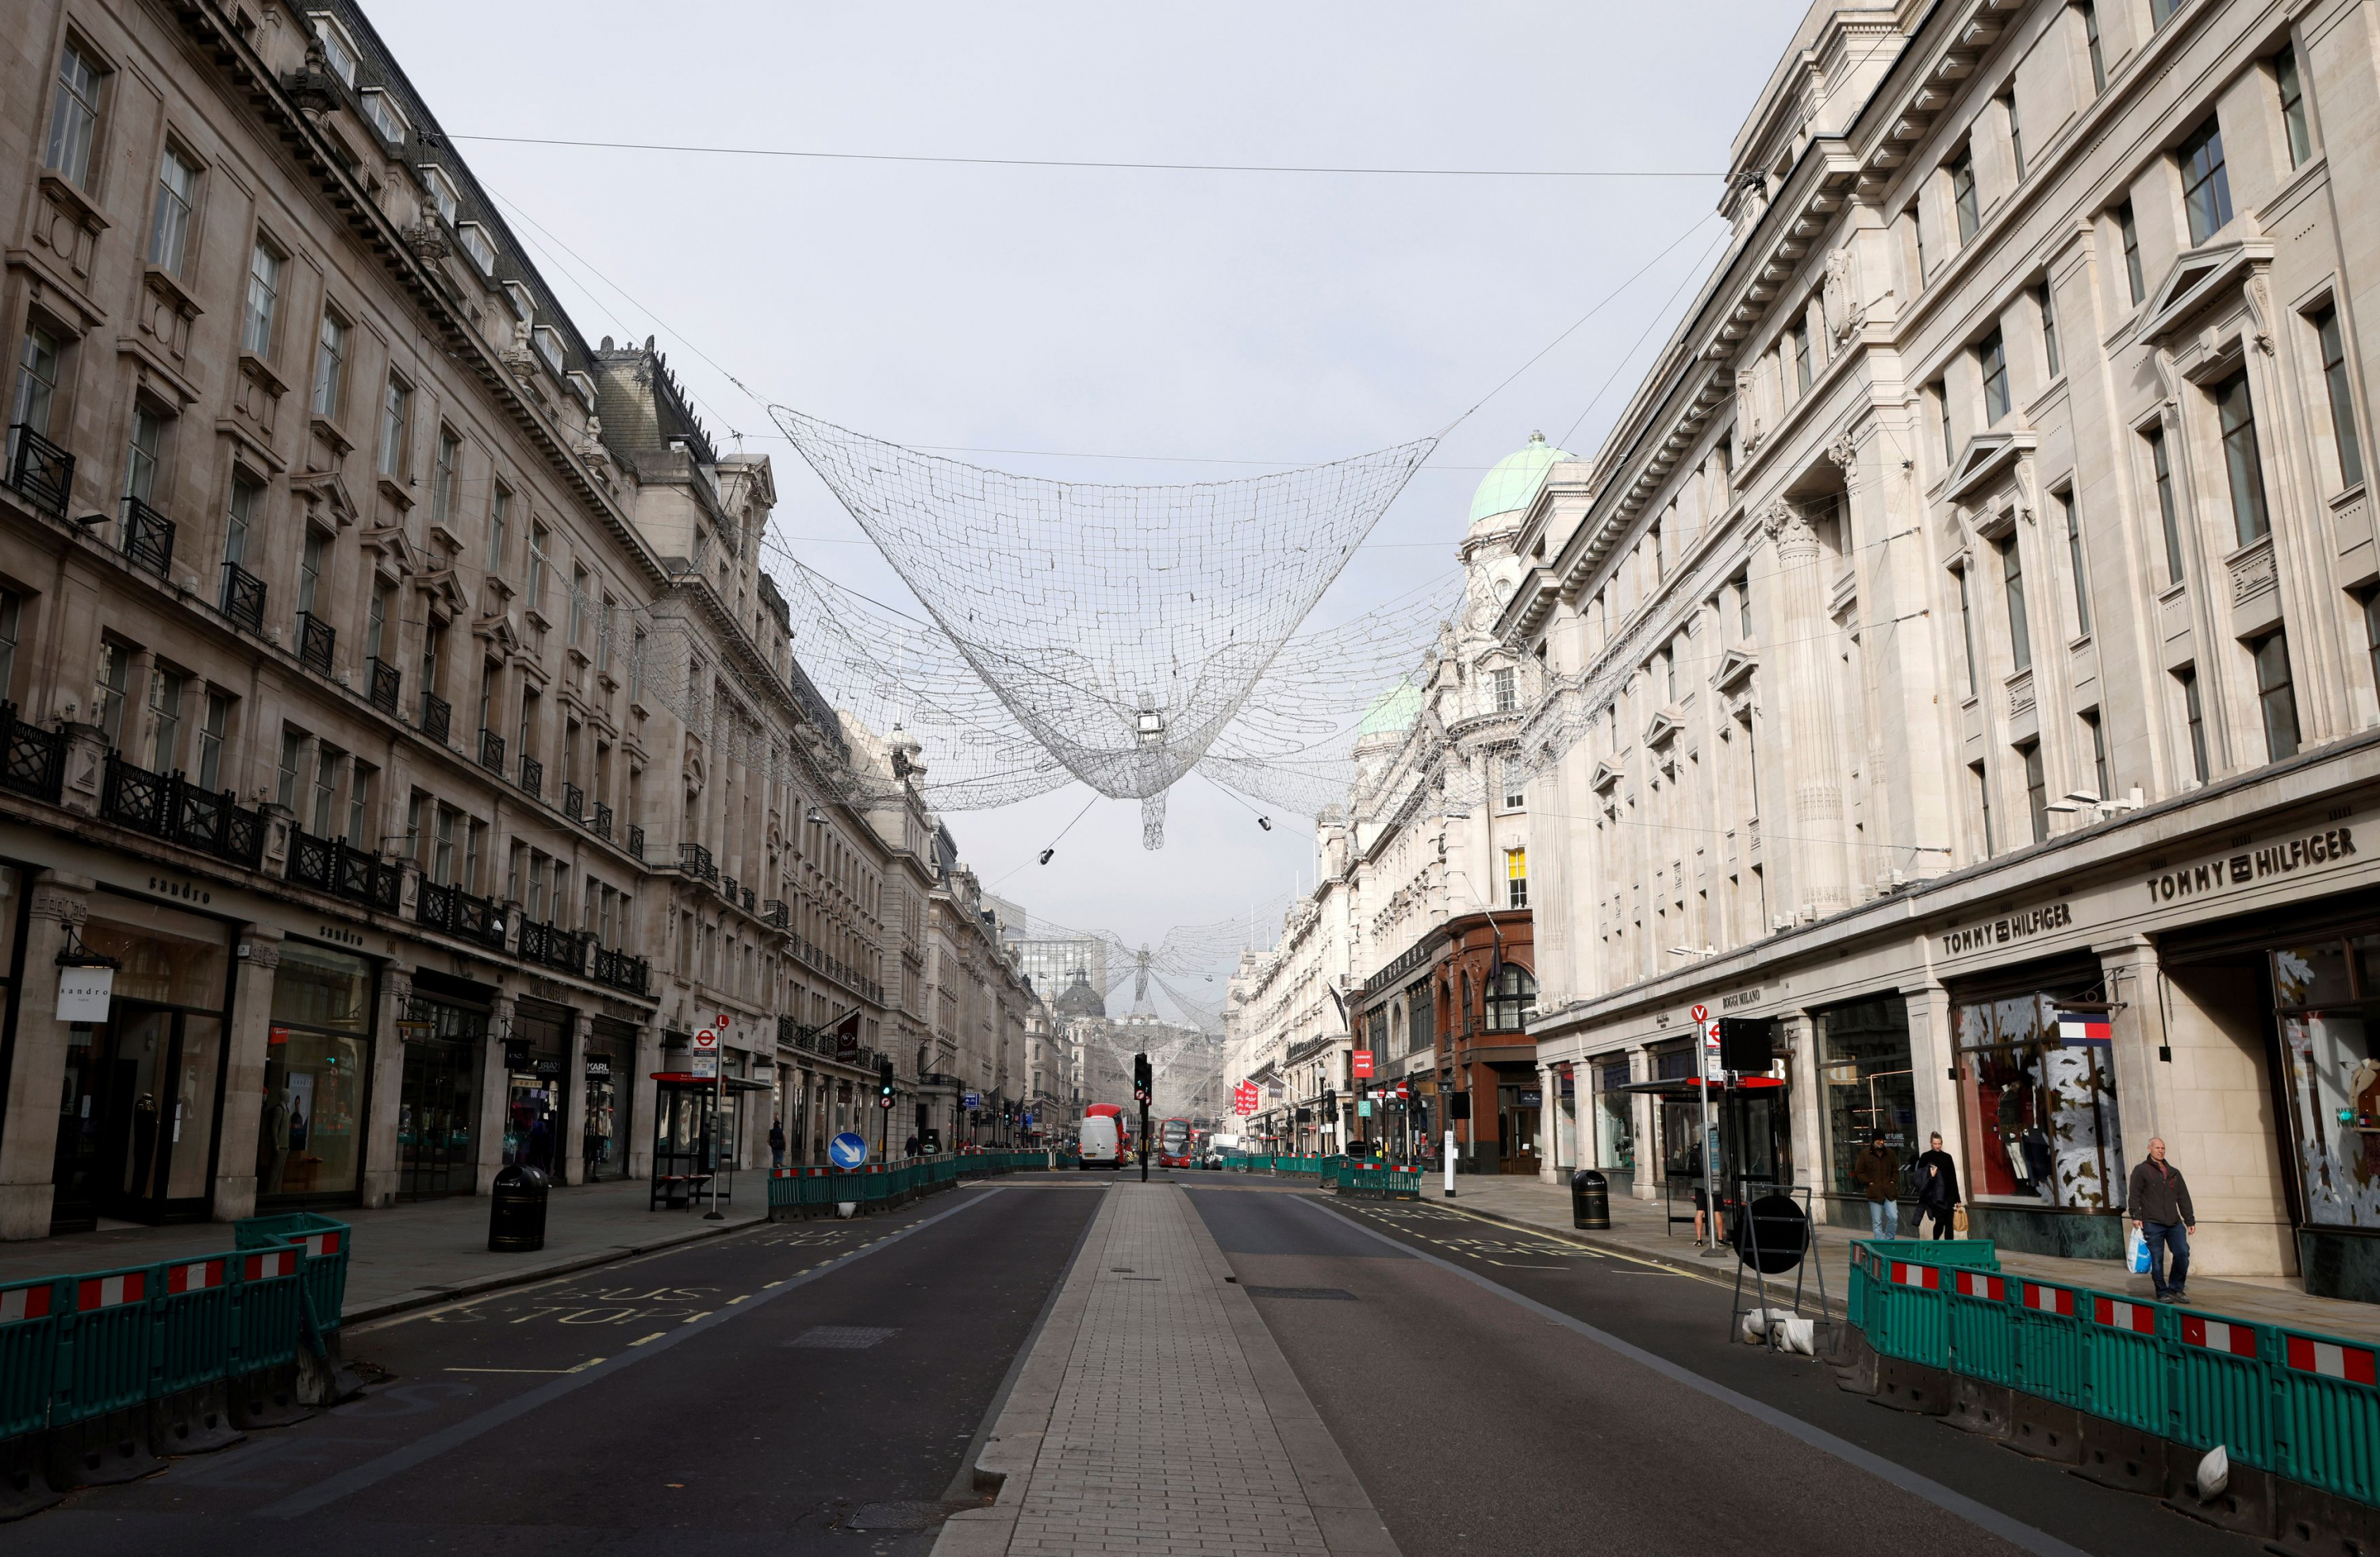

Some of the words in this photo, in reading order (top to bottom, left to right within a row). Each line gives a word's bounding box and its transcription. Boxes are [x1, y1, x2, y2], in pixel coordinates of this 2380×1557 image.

[2147, 860, 2224, 904] TOMMY
[2256, 828, 2357, 878] HILFIGER
[150, 877, 210, 905] sandro
[321, 925, 363, 947] sandro
[1943, 924, 1992, 955] TOMMY
[2011, 903, 2072, 939] HILFIGER
[61, 987, 108, 996] sandro
[720, 1017, 726, 1026] L
[1694, 1007, 1705, 1020] V
[587, 1063, 609, 1071] KARL
[532, 1286, 722, 1301] BUS
[428, 1305, 700, 1325] STOP
